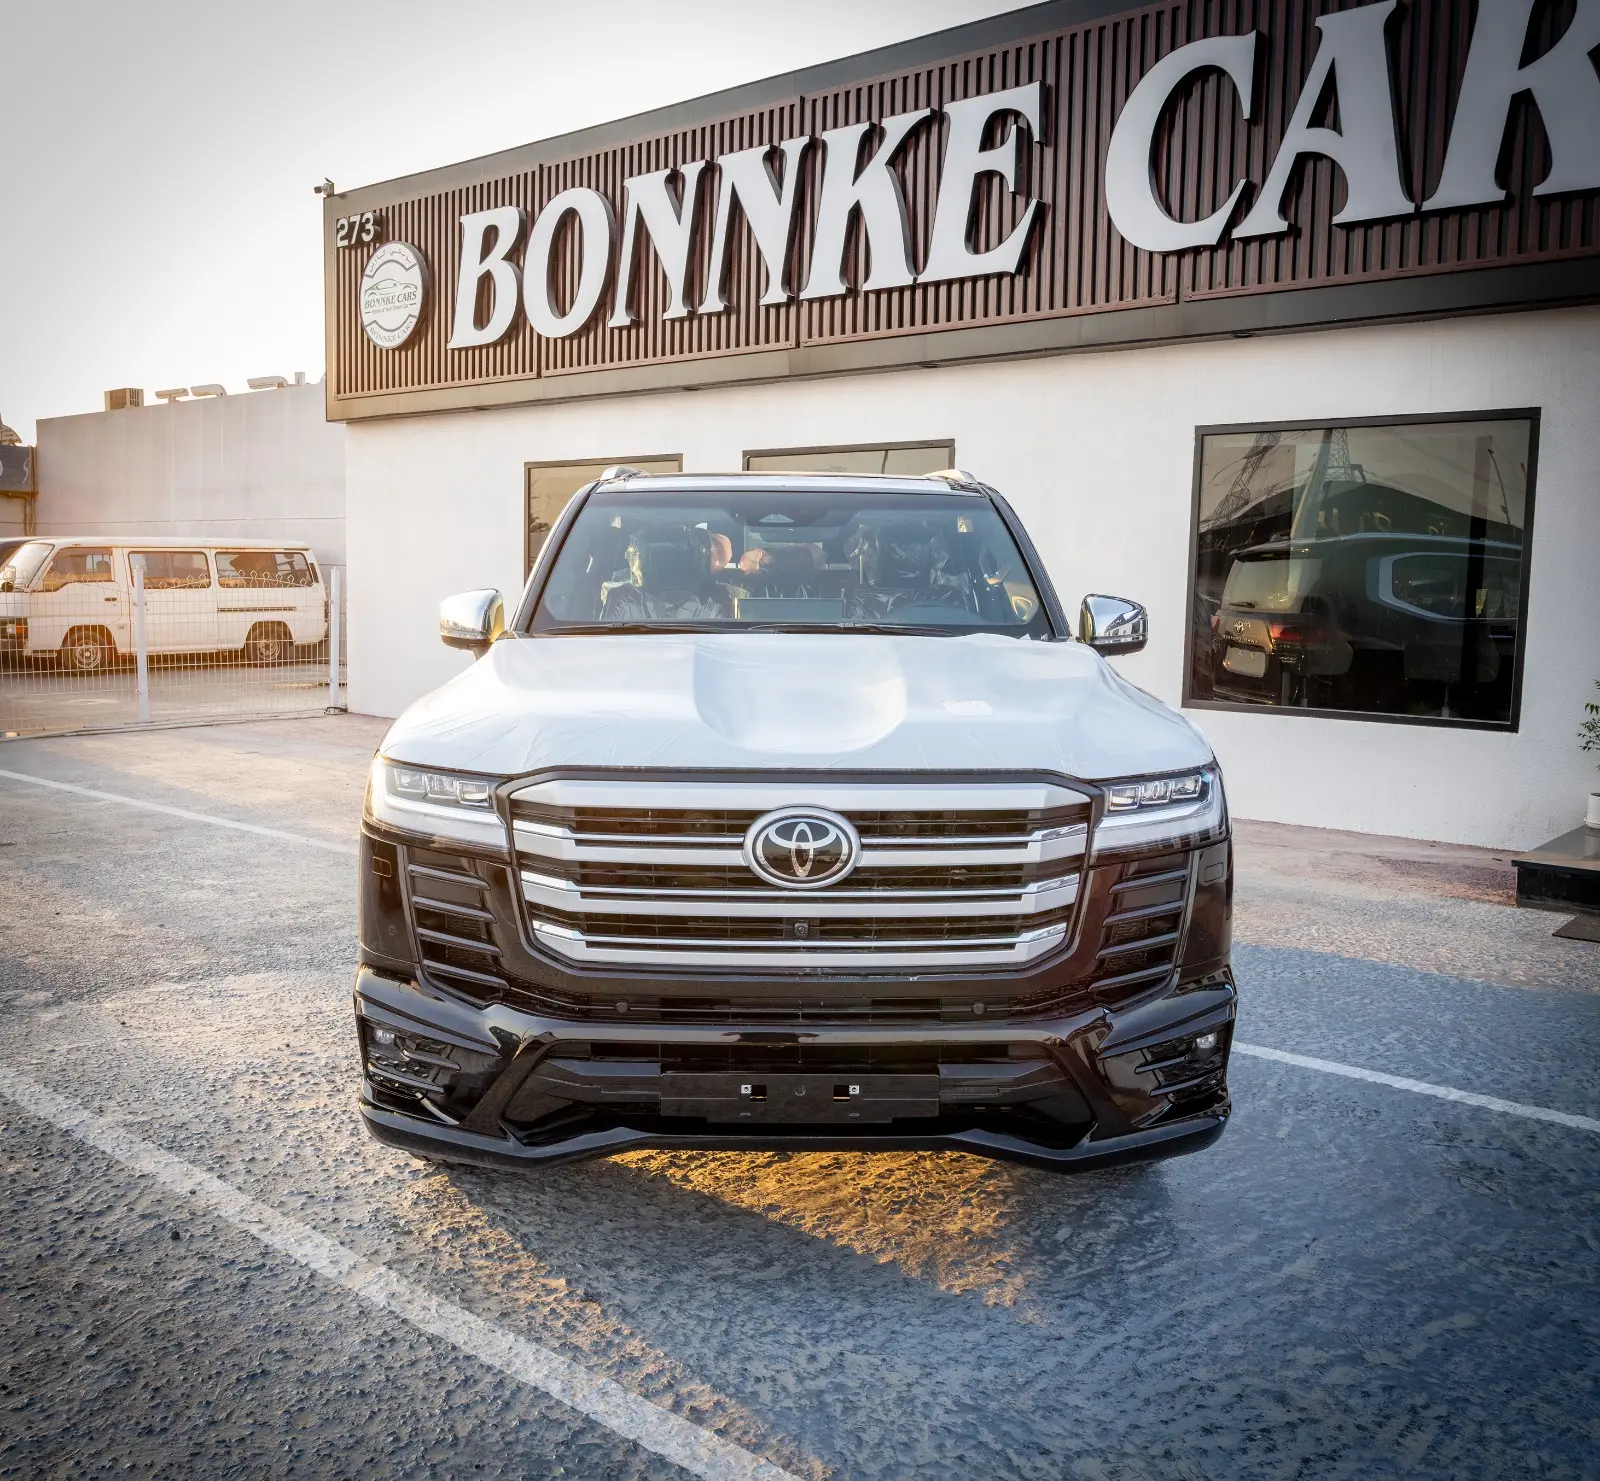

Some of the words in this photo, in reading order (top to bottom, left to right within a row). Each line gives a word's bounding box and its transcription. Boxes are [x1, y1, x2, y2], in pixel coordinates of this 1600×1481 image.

[336, 211, 375, 248] 273
[447, 80, 1047, 350] BONNKE
[364, 294, 396, 309] BONNKE
[396, 290, 417, 303] CARS
[369, 326, 398, 343] BONNKE
[397, 318, 413, 340] CARS
